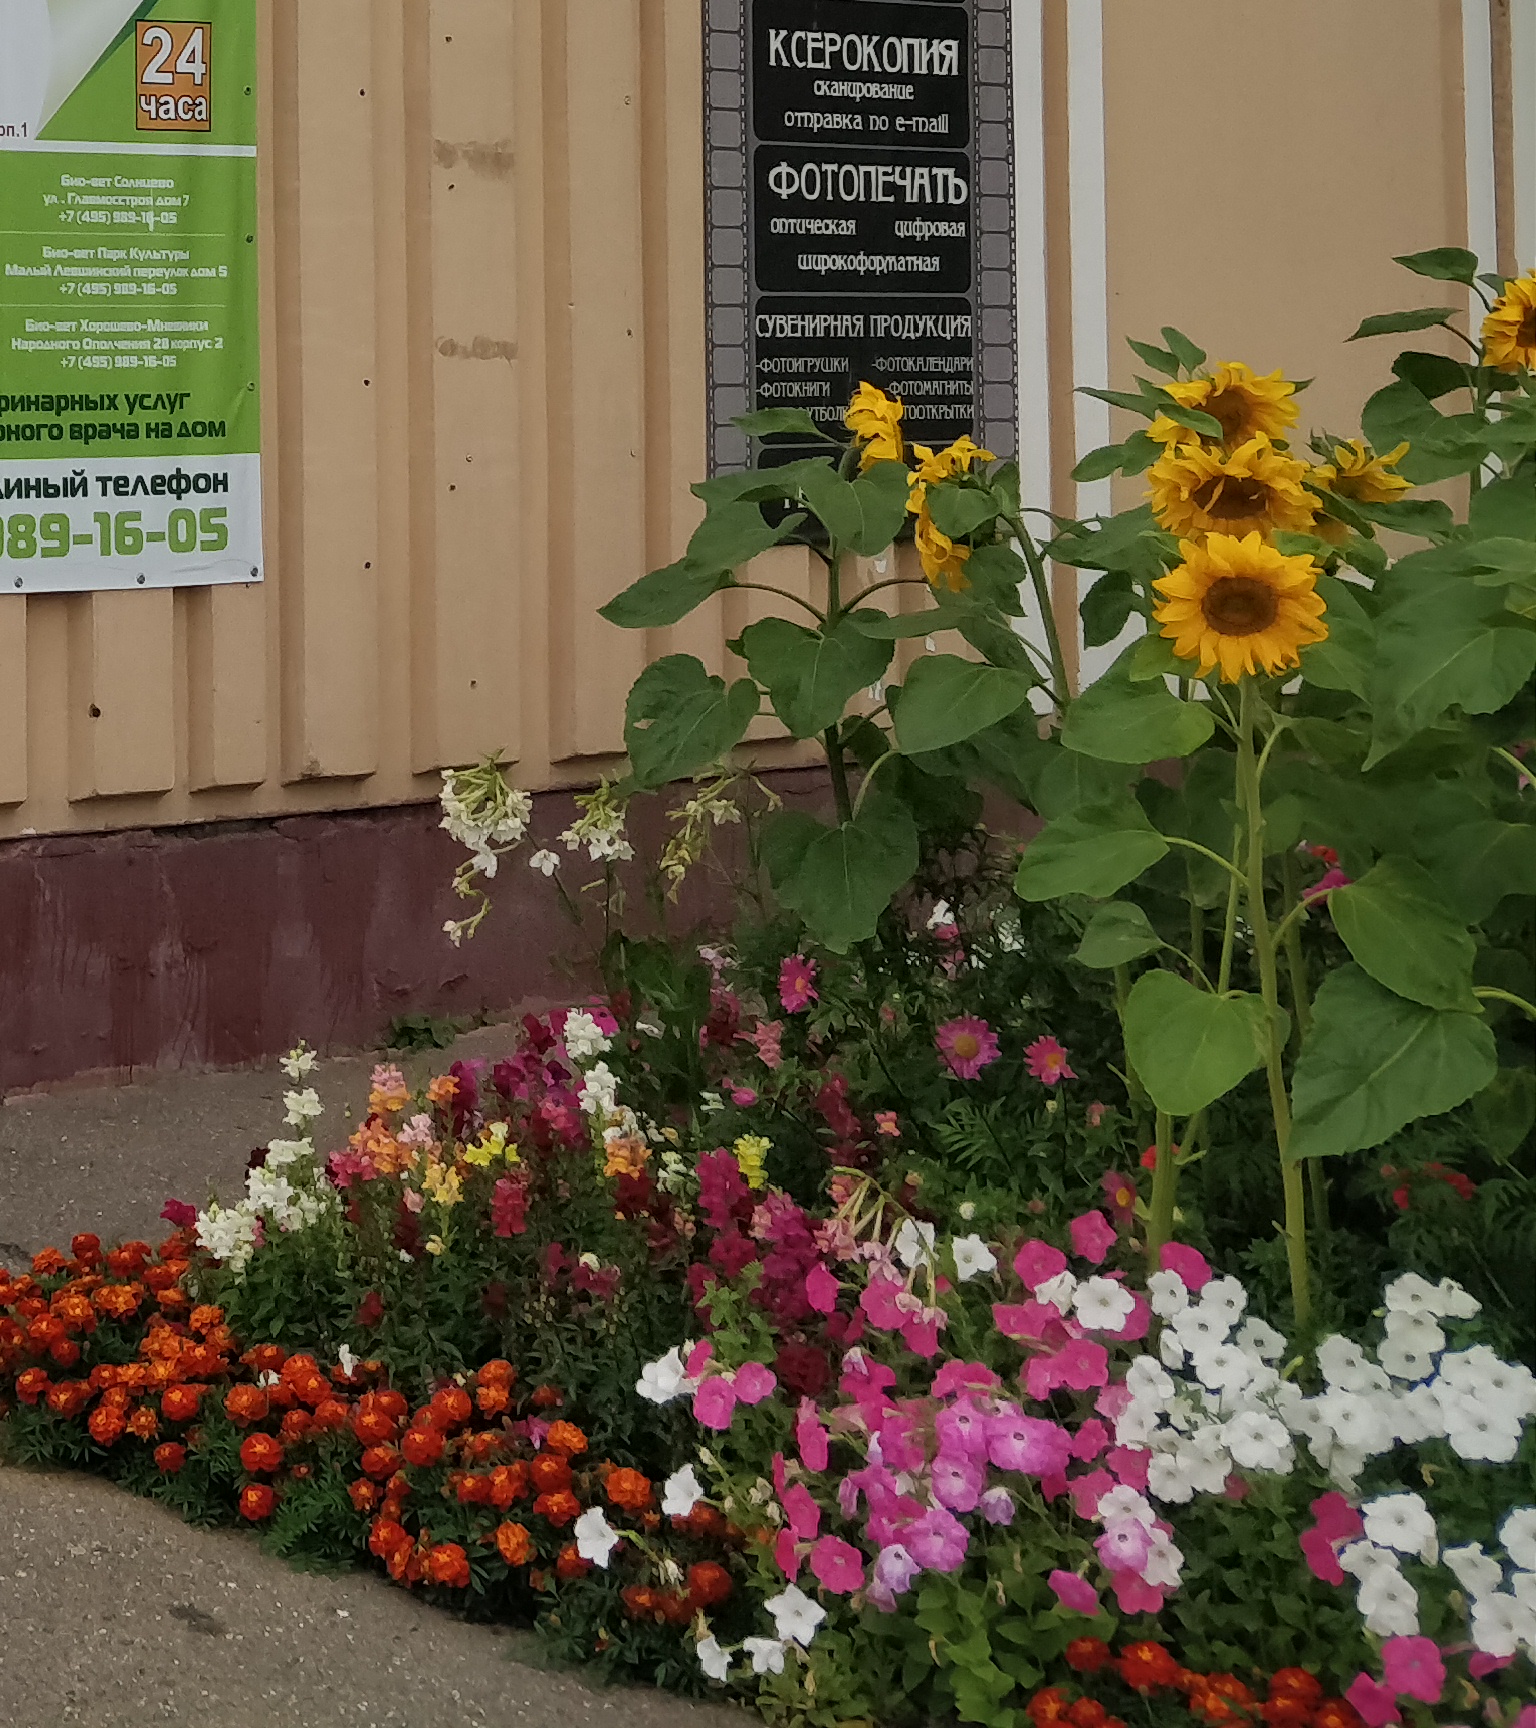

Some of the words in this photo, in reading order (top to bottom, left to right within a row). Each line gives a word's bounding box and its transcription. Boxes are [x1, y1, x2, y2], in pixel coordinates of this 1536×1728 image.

[141, 26, 208, 87] 24
[768, 28, 960, 76] КСЕРОКОПИЯ
[813, 79, 915, 103] сканирование
[140, 94, 209, 123] часа
[784, 110, 864, 133] отправка
[869, 117, 890, 133] по
[895, 113, 949, 135] e-mail
[60, 173, 112, 188] Био-вет
[114, 175, 175, 189] Солнцево
[767, 161, 969, 206] ФОТОПЕЧАТЬ
[155, 195, 181, 206] дом
[182, 194, 190, 206] 7
[59, 209, 75, 222] +7
[76, 210, 111, 224] (495)
[770, 218, 857, 237] оптическая
[894, 216, 967, 242] цифровая
[42, 246, 96, 260] Био-вет
[97, 246, 128, 261] Парк
[129, 247, 190, 262] Культуры
[797, 251, 941, 276] широкоформатная
[5, 263, 52, 277] Малый
[190, 267, 216, 278] дом
[59, 282, 75, 295] +7
[77, 282, 112, 296] (495)
[113, 282, 177, 296] 989-16-05
[25, 318, 78, 333] Био-вет
[755, 314, 865, 339] СУВЕНИРНАЯ
[869, 314, 973, 341] ПРОДУКЦИЯ
[11, 337, 81, 353] Народного
[82, 337, 151, 351] Ополчения
[170, 339, 212, 352] корпус
[214, 337, 224, 350] 2
[60, 355, 76, 368] +7
[77, 355, 113, 370] (495)
[114, 355, 177, 369] 989-16-05
[123, 390, 191, 417] услуг
[69, 420, 141, 445] врача
[145, 420, 173, 441] на
[176, 419, 227, 440] дом
[95, 467, 230, 501] телефон
